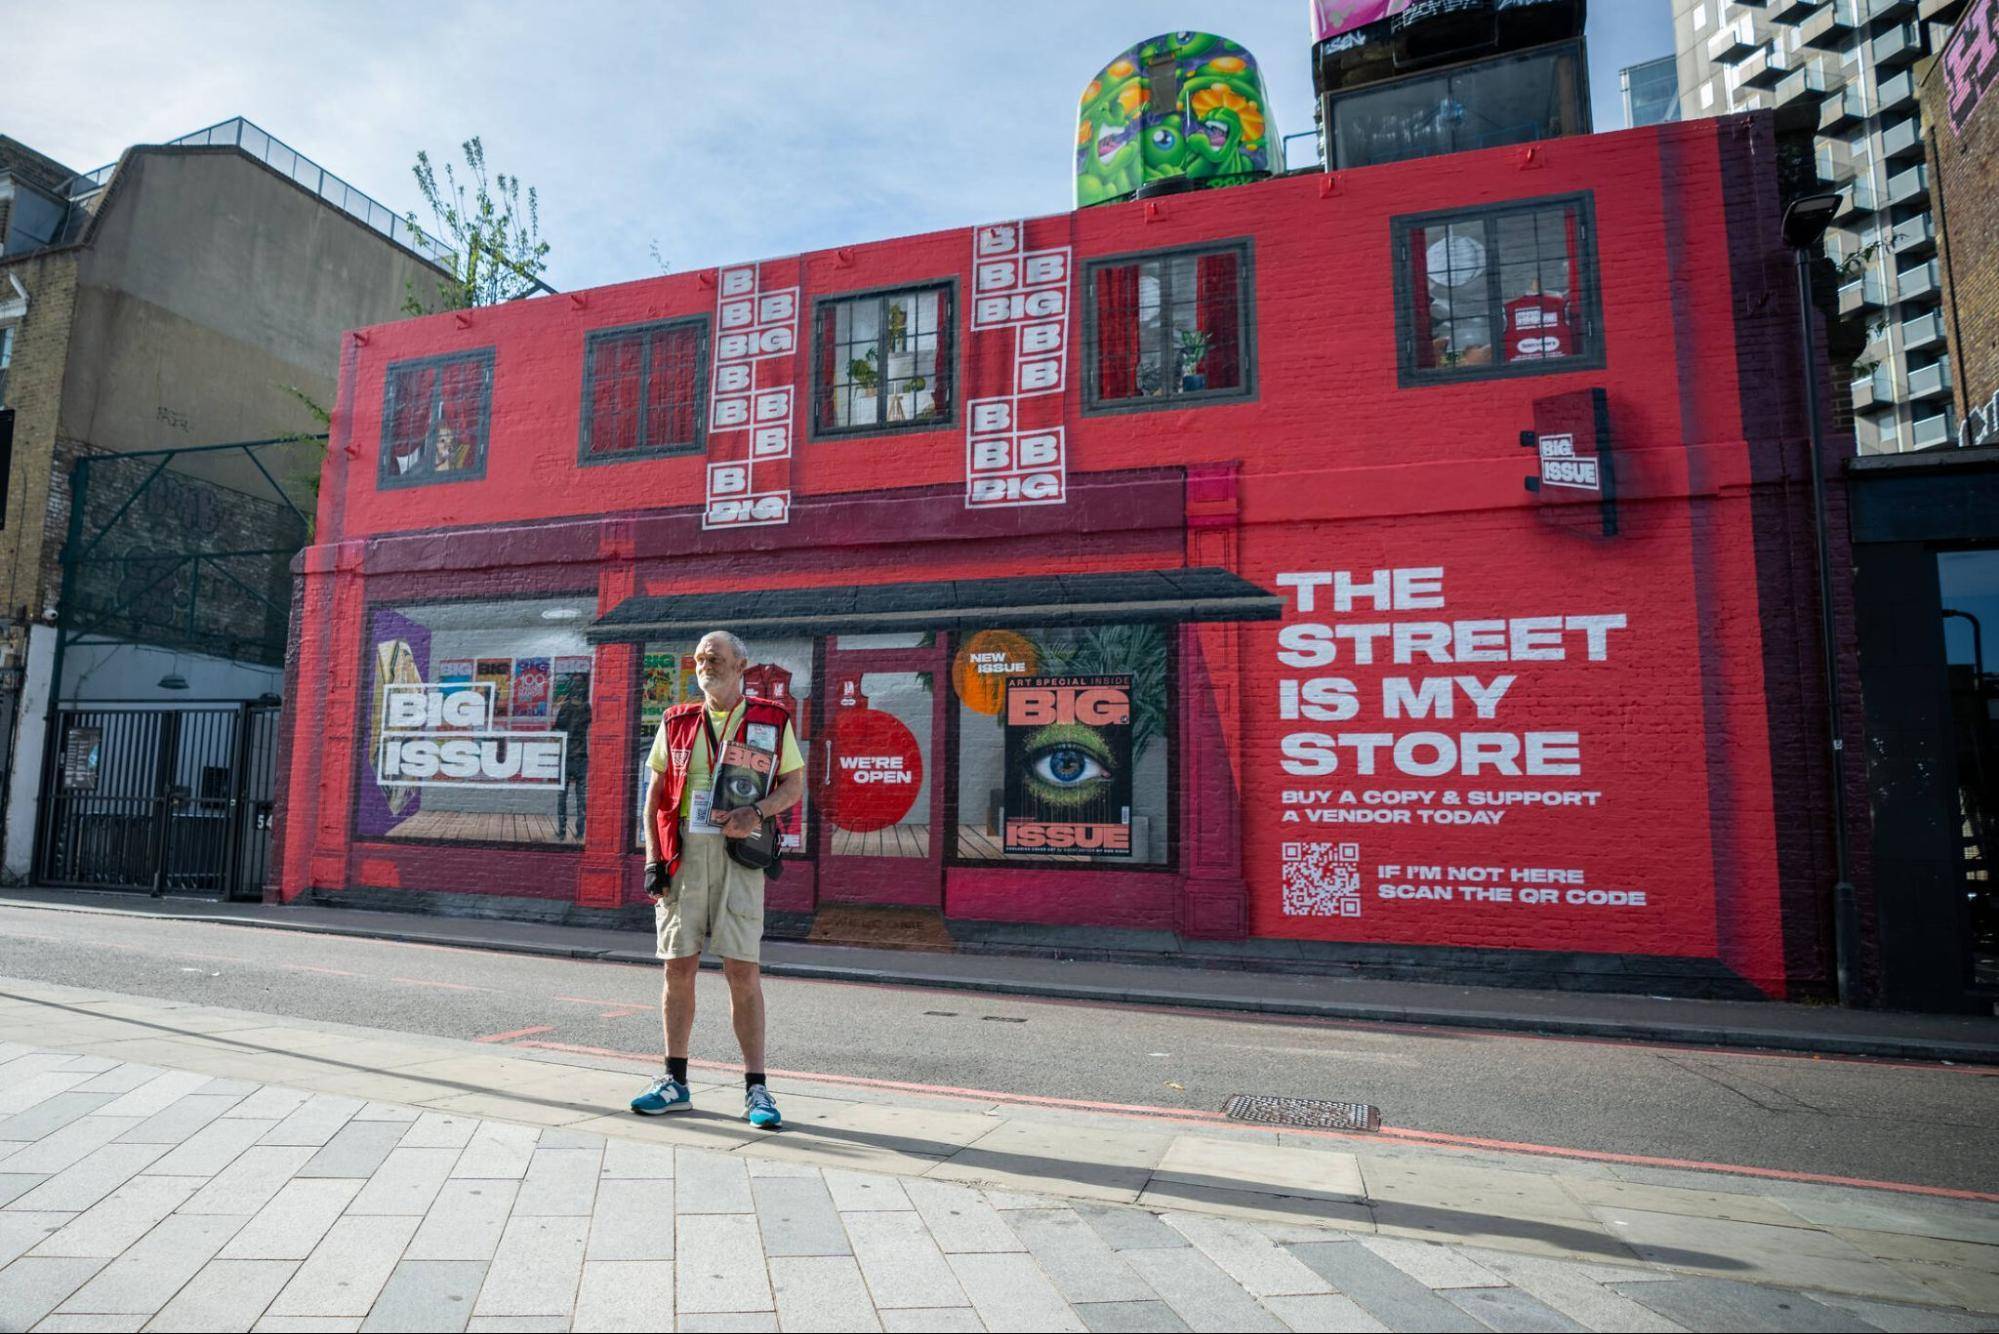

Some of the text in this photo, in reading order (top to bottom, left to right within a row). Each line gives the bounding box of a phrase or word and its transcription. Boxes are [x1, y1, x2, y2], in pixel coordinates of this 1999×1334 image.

[722, 269, 753, 296] B
[979, 254, 1064, 291] B B
[721, 294, 793, 329] B B
[977, 290, 1063, 324] BIG
[719, 327, 792, 360] BIG
[1023, 323, 1060, 353] B
[717, 365, 750, 392] B
[1021, 360, 1059, 390] B
[716, 393, 788, 426] B B
[974, 402, 1010, 432] B
[755, 427, 787, 455] B
[974, 435, 1058, 470] B B
[1541, 438, 1573, 457] BIG
[713, 467, 745, 494] B
[1544, 460, 1597, 484] ISSUE
[972, 473, 1059, 501] BIG
[708, 496, 785, 523] BIG
[1276, 566, 1445, 612] THE
[1277, 613, 1627, 667] STREET
[970, 652, 1006, 663] NEW
[978, 661, 1025, 673] ISSUE
[1008, 676, 1130, 687] ART SPECIAL INSIDE
[388, 690, 486, 727] BIG
[1008, 689, 1130, 725] BIG
[1279, 675, 1519, 721] IS MY
[384, 739, 561, 779] ISSUE
[722, 745, 772, 774] BIG
[840, 757, 903, 770] WE'RE
[1280, 731, 1581, 776] STORE
[853, 771, 912, 784] OPEN
[1281, 790, 1602, 805] BUY A COPY & SUPPORT
[1282, 809, 1505, 824] A VENDOR TODAY
[1006, 825, 1129, 849] ISSUE
[1378, 865, 1584, 884] IF I'M NOT HERE
[1378, 884, 1647, 906] SCAN THE QR CODE
